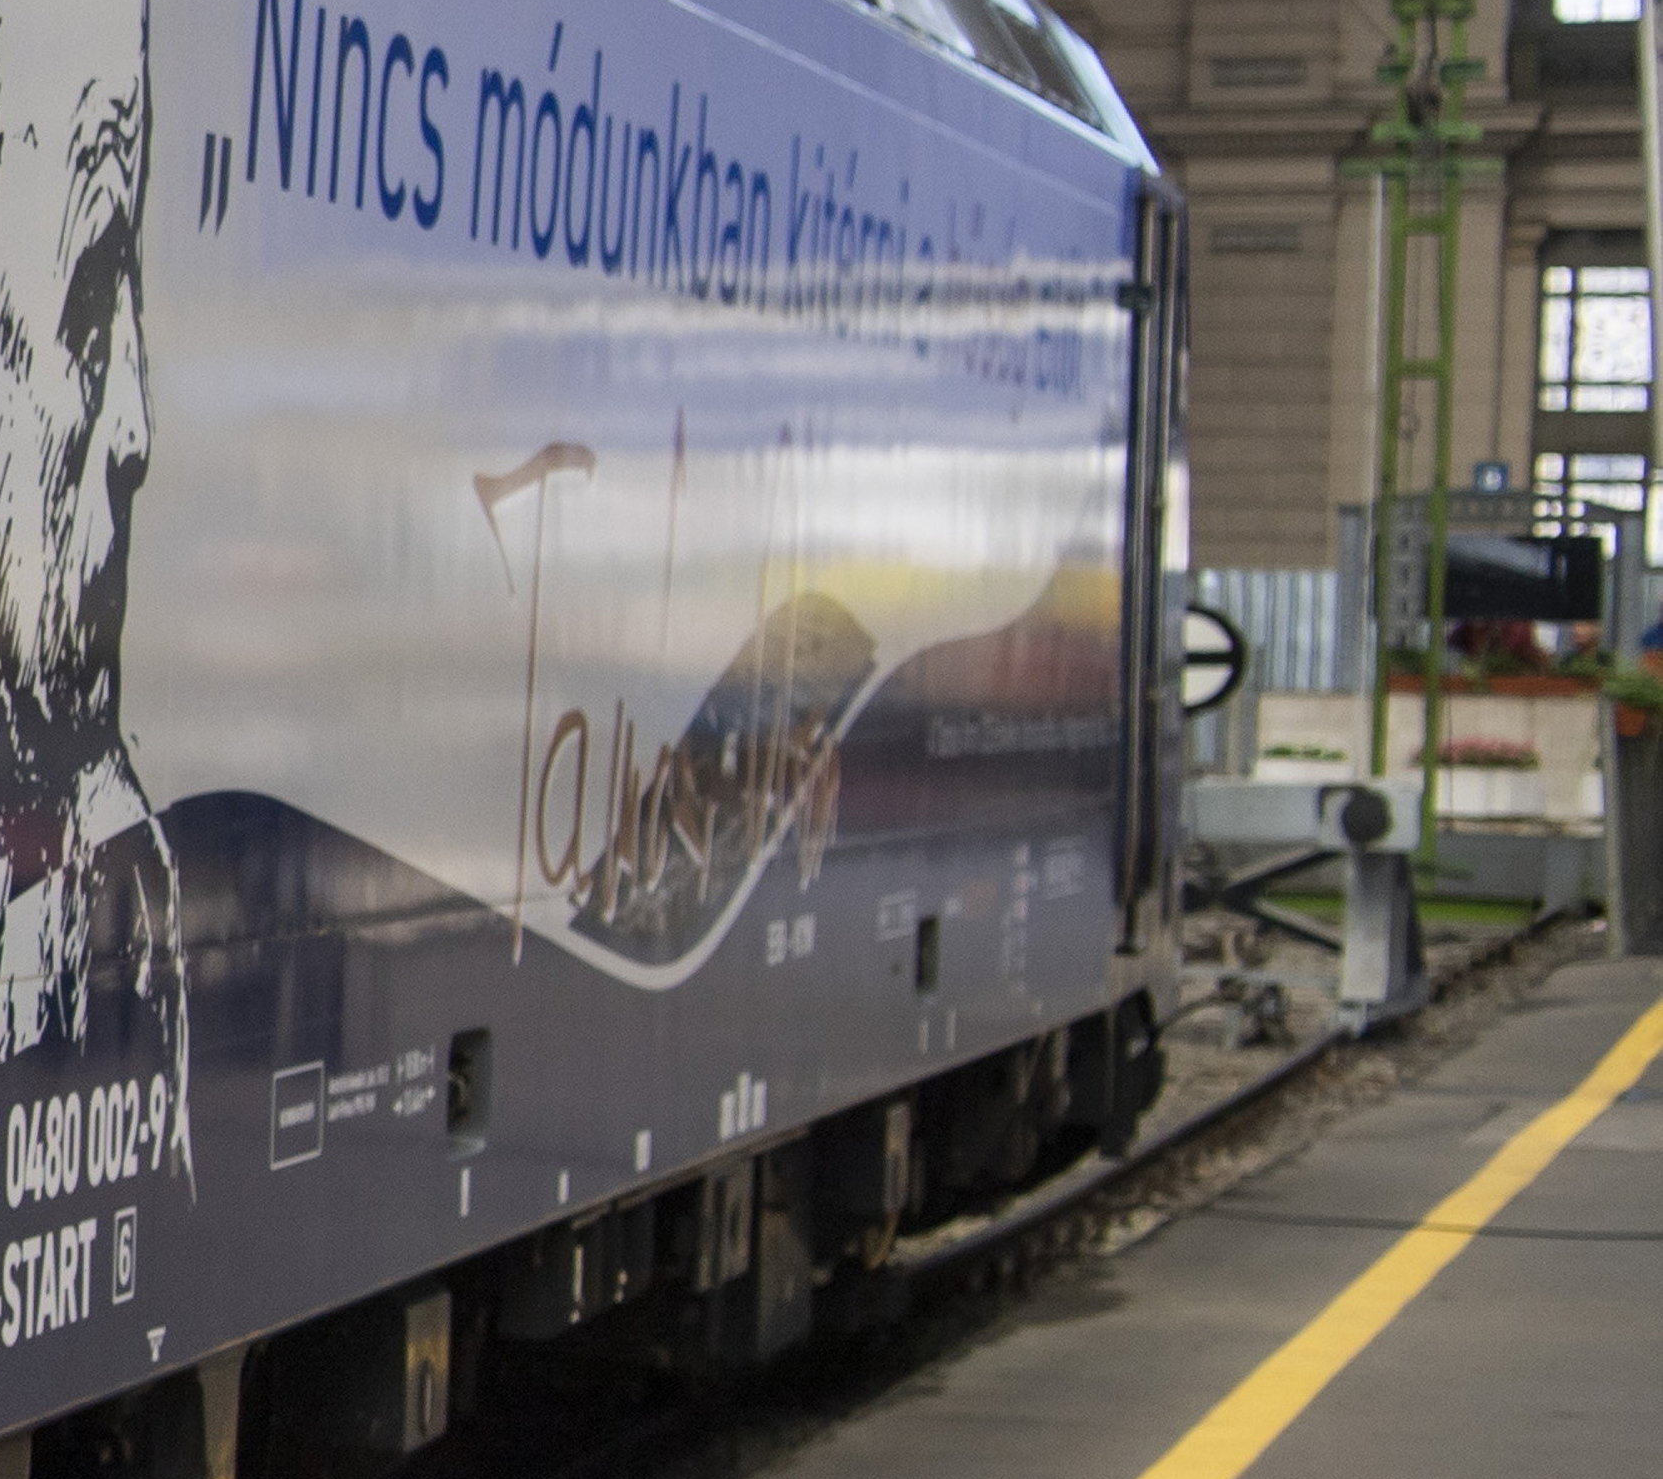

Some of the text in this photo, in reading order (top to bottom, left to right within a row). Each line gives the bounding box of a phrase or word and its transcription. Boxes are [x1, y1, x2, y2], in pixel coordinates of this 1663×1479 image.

[470, 21, 772, 315] módunkban
[6, 1091, 82, 1209] 0480
[87, 1073, 168, 1188] 002-9
[117, 1222, 133, 1287] 6
